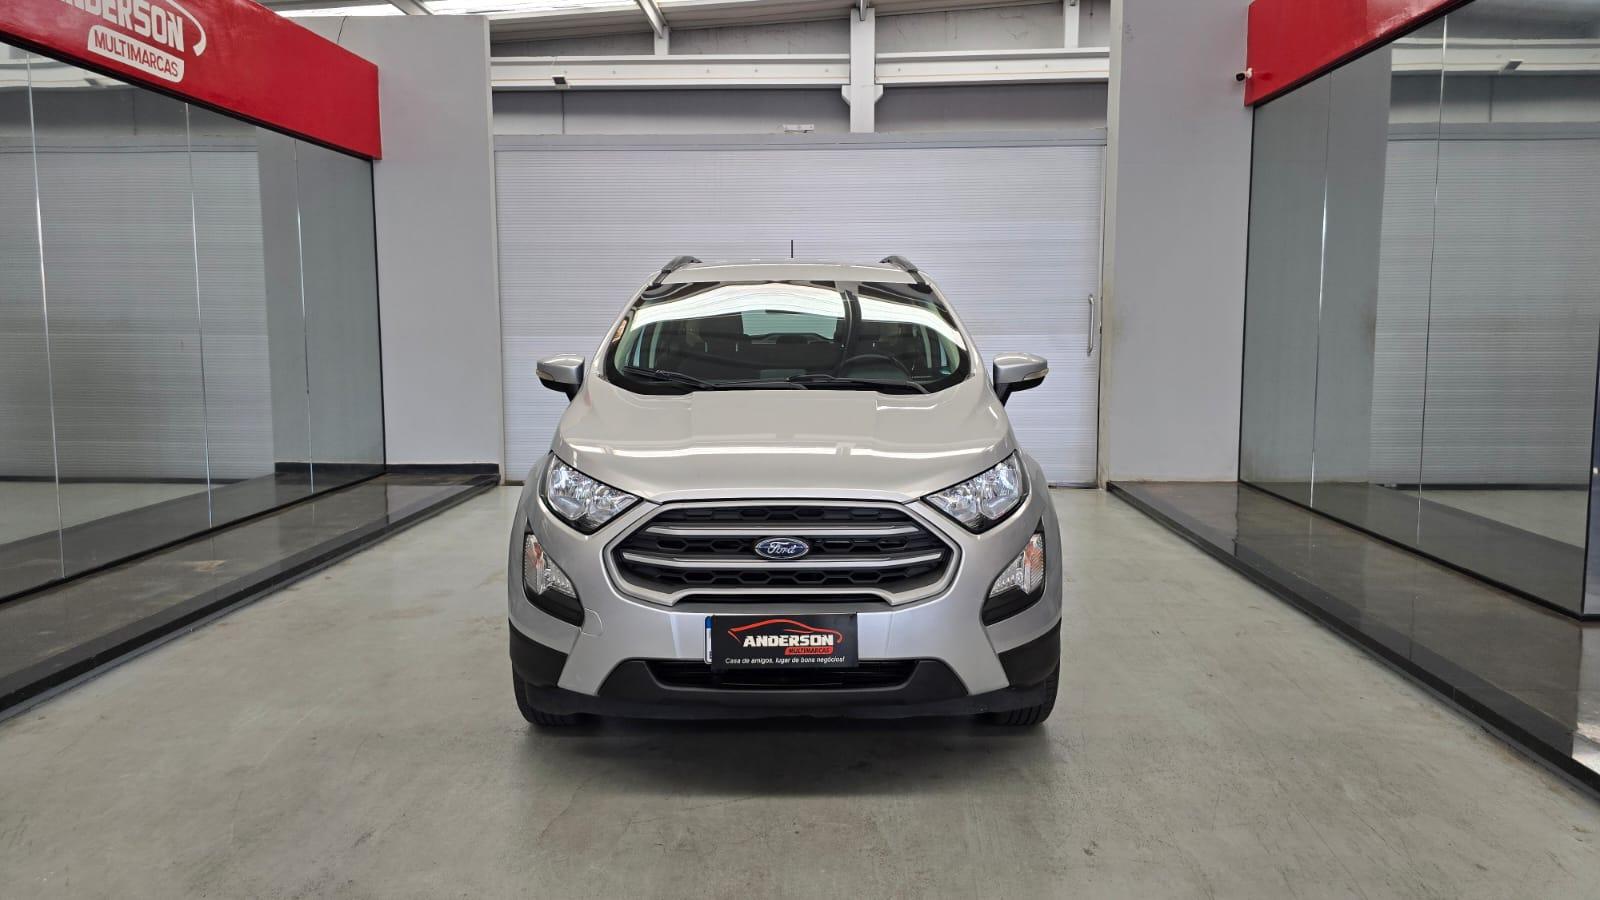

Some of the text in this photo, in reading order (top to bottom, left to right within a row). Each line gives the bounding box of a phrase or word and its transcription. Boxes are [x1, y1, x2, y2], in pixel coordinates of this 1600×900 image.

[60, 0, 185, 52] DERSON
[94, 29, 178, 77] MULTIMARCAS
[767, 541, 797, 554] Ford
[743, 634, 834, 648] ANDERSON
[775, 657, 791, 665] lugar
